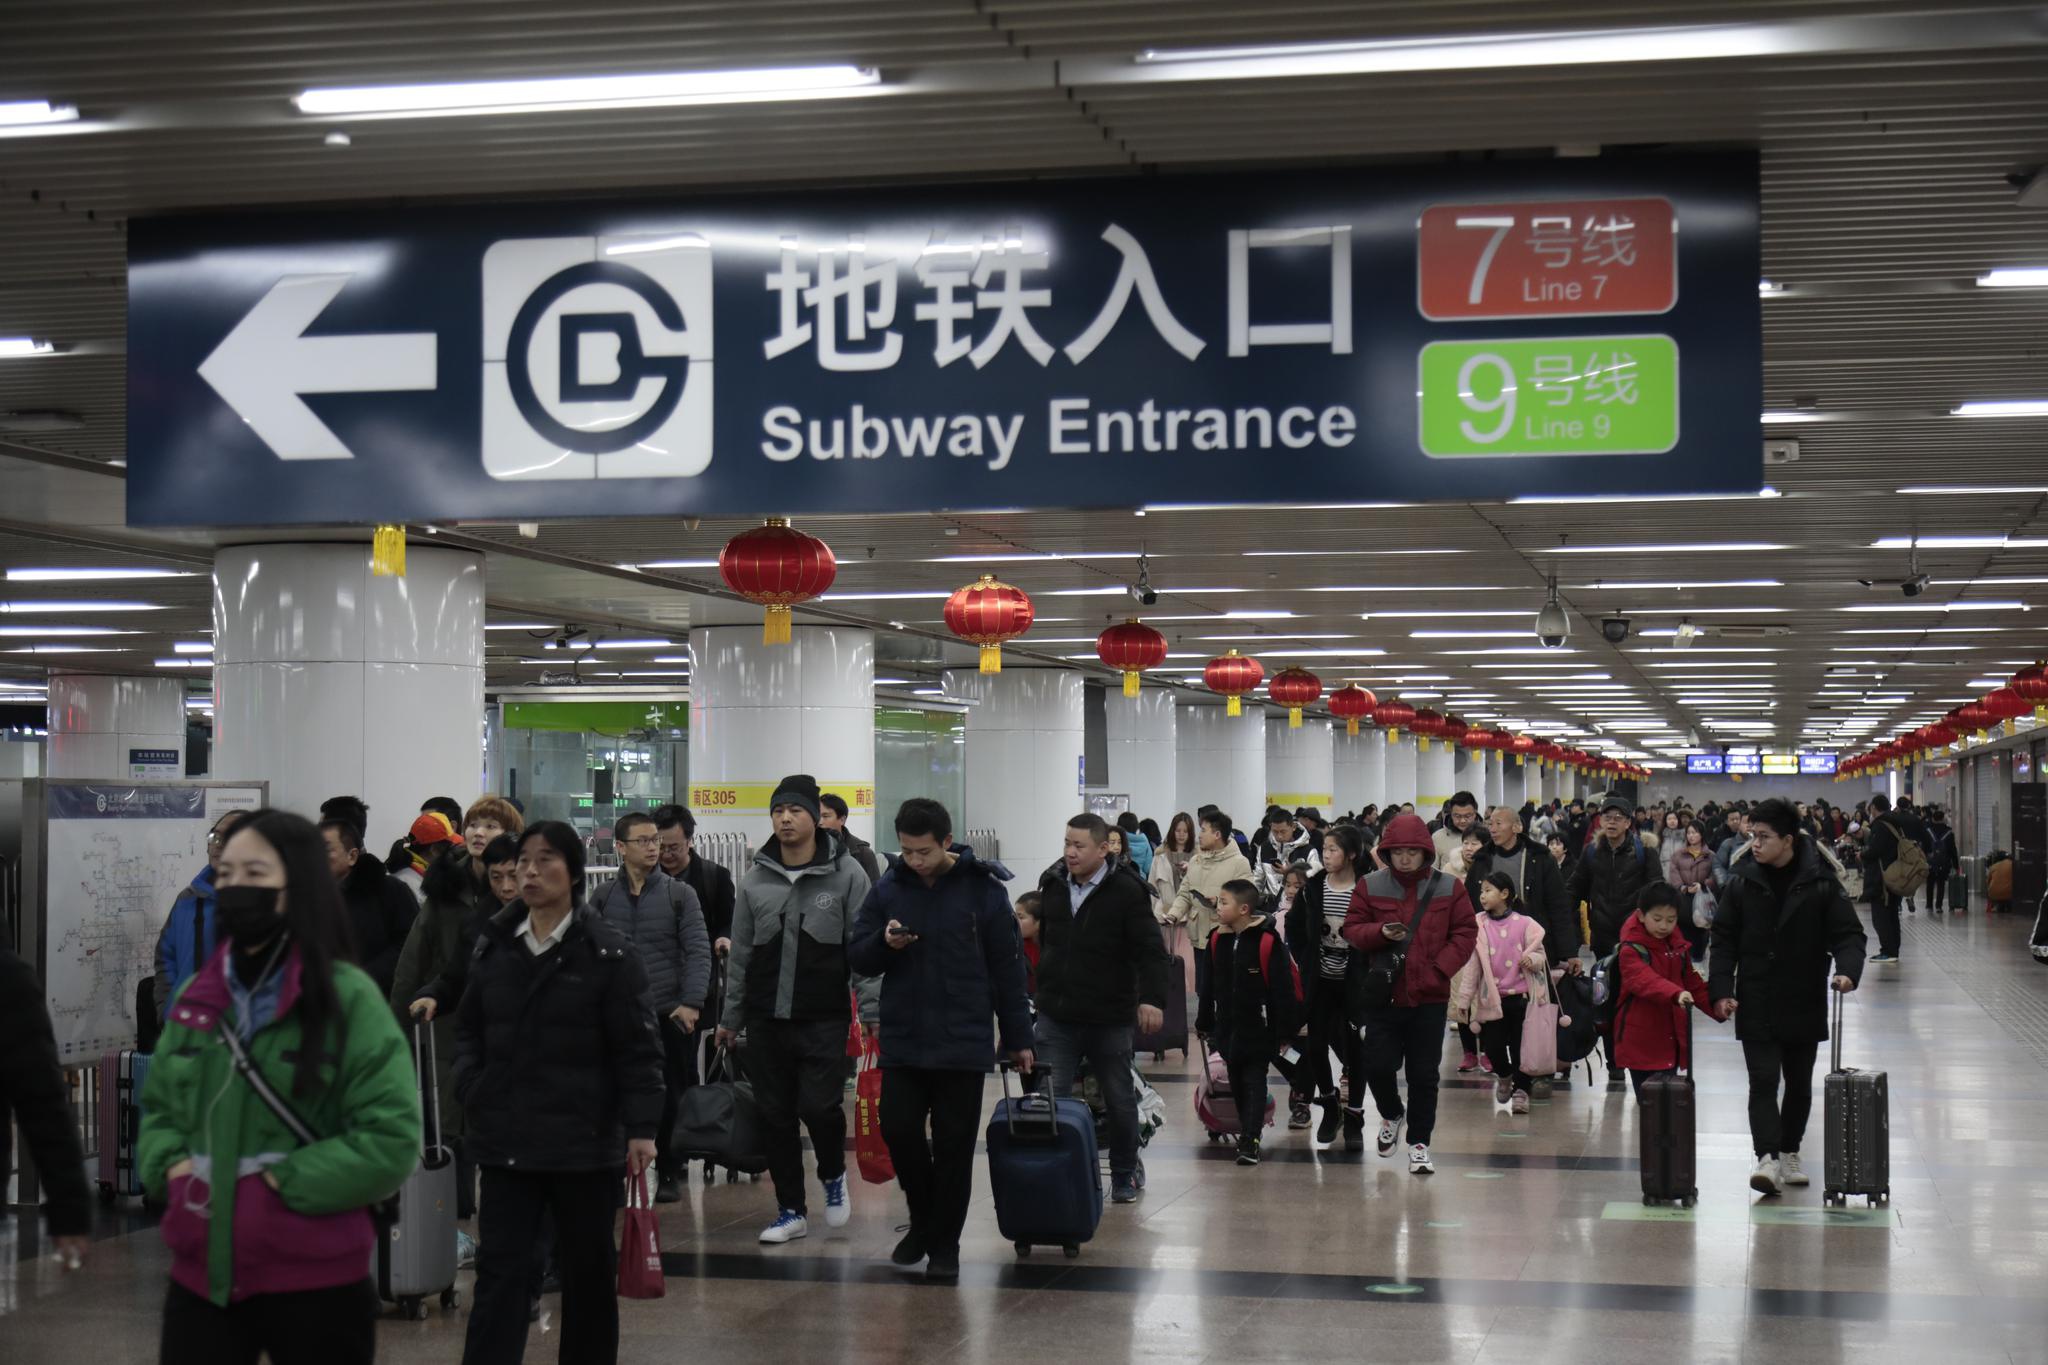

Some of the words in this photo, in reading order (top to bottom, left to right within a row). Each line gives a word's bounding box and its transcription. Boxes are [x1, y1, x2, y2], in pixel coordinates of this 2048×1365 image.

[763, 223, 1353, 370] 地铁入口
[1522, 278, 1583, 303] Line
[1591, 275, 1609, 300] 7
[761, 404, 1025, 470] Subway
[1049, 398, 1358, 455] Entrance
[1524, 416, 1585, 440] Line
[1594, 413, 1612, 440] 9
[692, 789, 737, 807] 南区305
